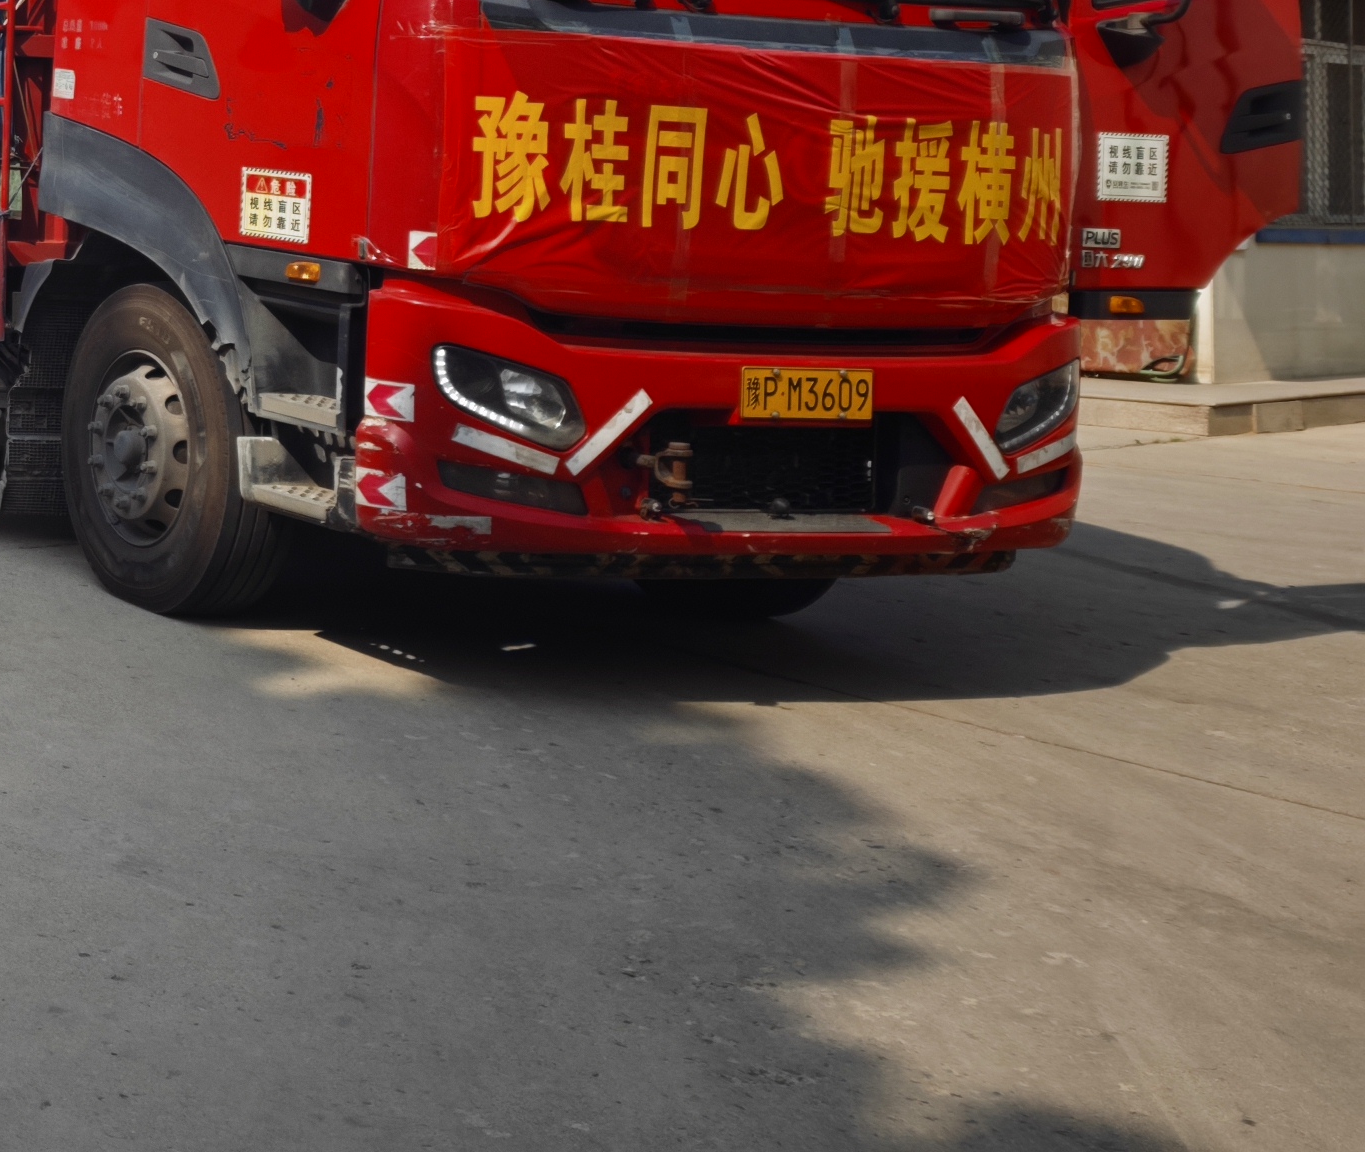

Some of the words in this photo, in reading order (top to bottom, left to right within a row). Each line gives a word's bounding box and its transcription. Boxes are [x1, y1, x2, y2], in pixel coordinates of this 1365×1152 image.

[1109, 145, 1158, 161] 视线盲区
[472, 90, 784, 230] 豫桂同心
[825, 115, 1063, 246] 驰援横州
[1108, 161, 1158, 176] 请勿靠近
[270, 178, 297, 196] 危险
[250, 196, 301, 215] 视线盲区
[249, 213, 300, 232] 请勿靠近
[1084, 230, 1119, 246] PLUS
